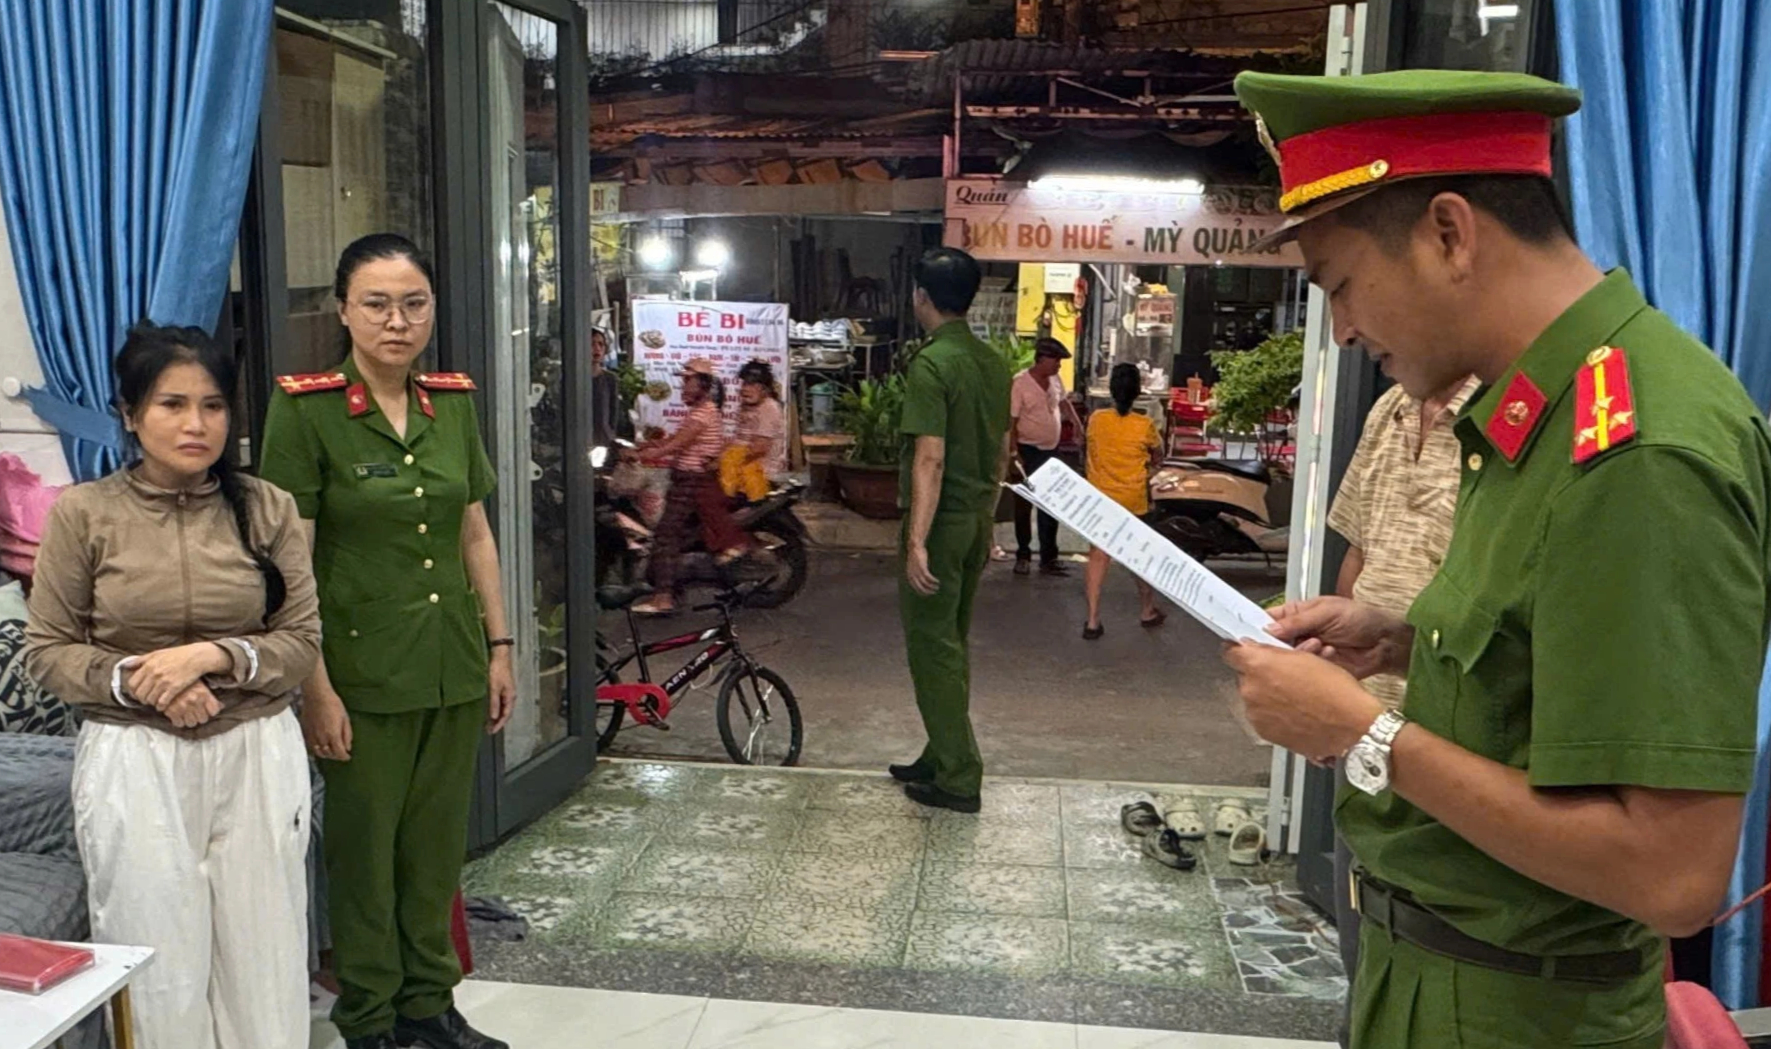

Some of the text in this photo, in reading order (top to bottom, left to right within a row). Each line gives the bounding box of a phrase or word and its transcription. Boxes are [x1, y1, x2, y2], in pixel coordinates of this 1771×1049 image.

[1017, 216, 1051, 248] BÒ
[1062, 214, 1115, 250] HUẾ
[1143, 220, 1183, 253] MỲ
[720, 313, 745, 329] BI
